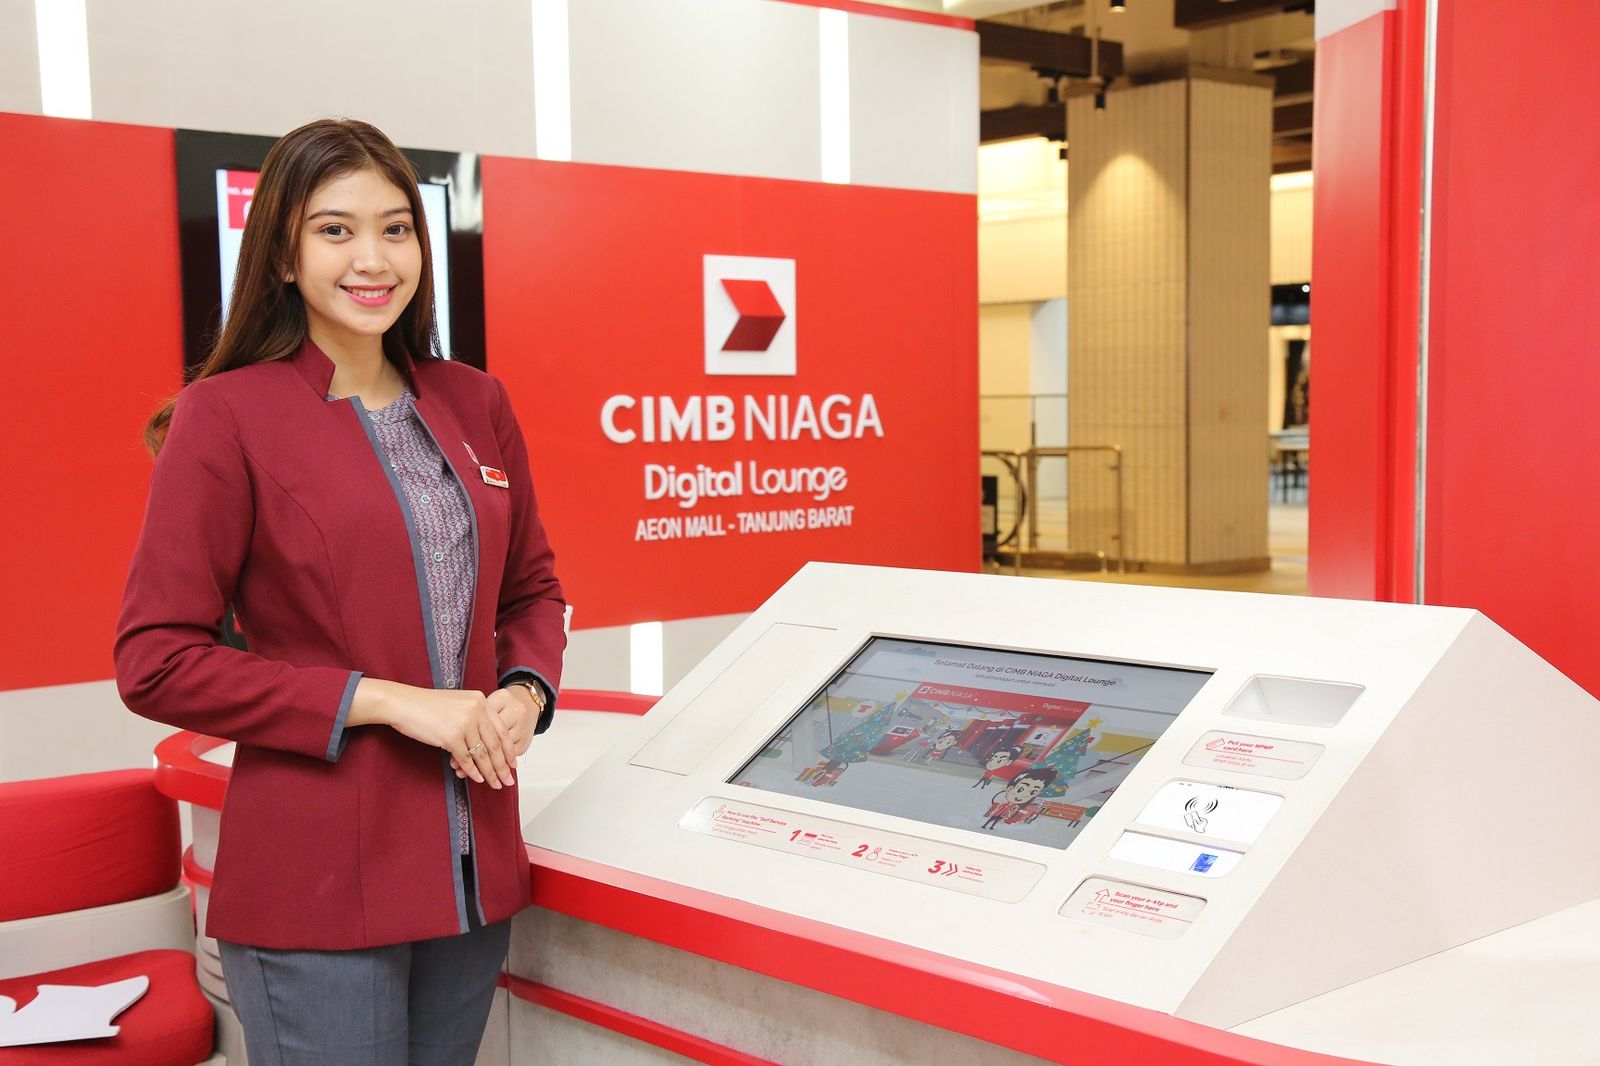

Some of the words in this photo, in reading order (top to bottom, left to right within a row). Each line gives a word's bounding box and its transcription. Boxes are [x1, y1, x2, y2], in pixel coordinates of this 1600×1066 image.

[600, 394, 736, 444] CIMB
[744, 394, 885, 441] NIAGA
[644, 461, 743, 508] Digital
[750, 460, 848, 501] Lounge
[635, 517, 682, 541] AEON
[685, 514, 727, 538] MALL
[736, 509, 806, 534] TANJUNG
[807, 506, 855, 530] BARAT
[934, 658, 966, 669] Selamat
[966, 662, 995, 673] Datang
[995, 665, 1005, 673] di
[1004, 667, 1026, 676] CIMB
[1024, 670, 1053, 679] NIAGA
[1053, 673, 1083, 683] Digital
[1083, 676, 1117, 687] Lounge
[929, 687, 951, 697] CIMB
[949, 690, 974, 699] NIAGA
[1042, 702, 1062, 711] Digital
[789, 829, 802, 842] 1
[850, 843, 869, 858] 2
[927, 859, 946, 874] 3
[1114, 891, 1131, 899] Scan
[1124, 899, 1145, 909] finger
[1144, 903, 1160, 912] here
